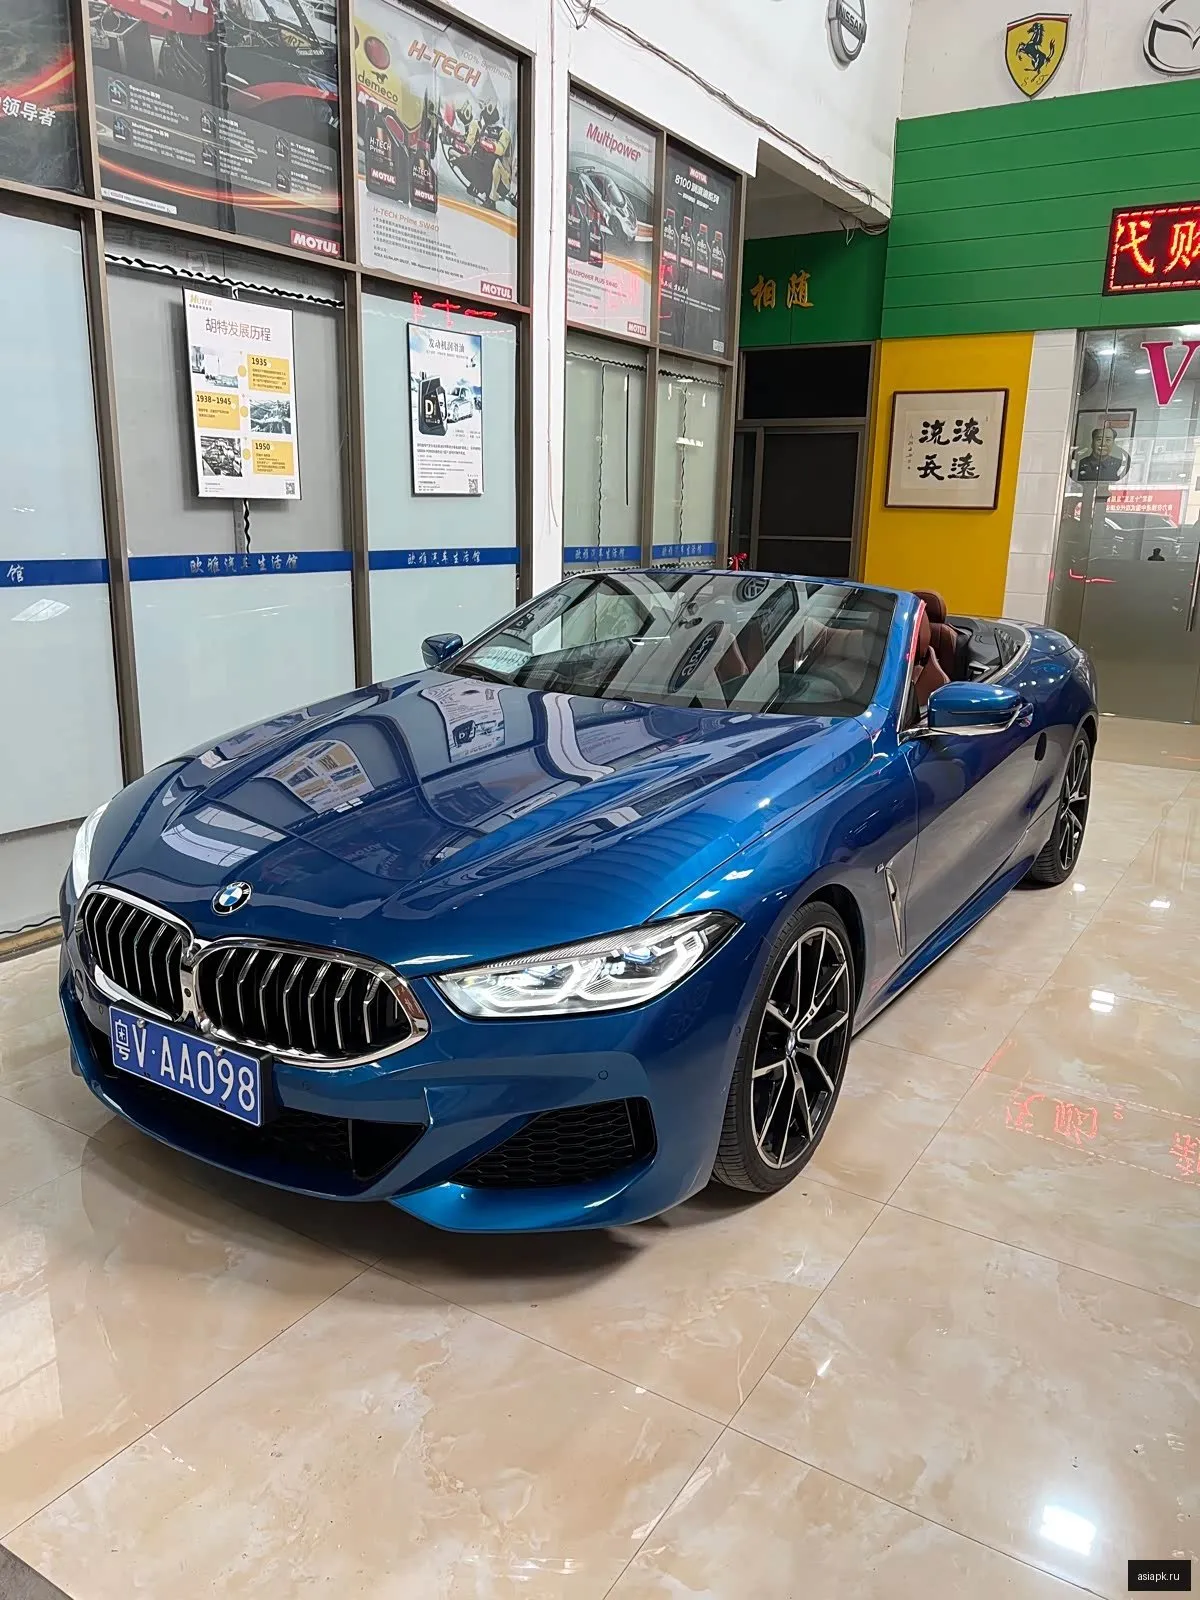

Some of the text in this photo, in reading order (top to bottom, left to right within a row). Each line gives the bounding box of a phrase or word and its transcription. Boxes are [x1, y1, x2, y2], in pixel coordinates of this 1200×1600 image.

[408, 40, 481, 88] H-TECH
[358, 70, 398, 102] demeco
[0, 96, 56, 126] 领导者
[586, 122, 641, 162] Multipower
[371, 169, 396, 184] MOTUL
[675, 174, 692, 190] 8100
[414, 189, 435, 202] MOTUL
[373, 207, 398, 219] H-TECH
[293, 232, 339, 255] MOTUL
[482, 283, 512, 298] MOTUL
[205, 317, 271, 342] 胡特发展历程
[628, 322, 647, 335] MOTUL
[251, 357, 268, 367] 1935
[425, 399, 434, 415] D
[255, 442, 271, 451] 1950
